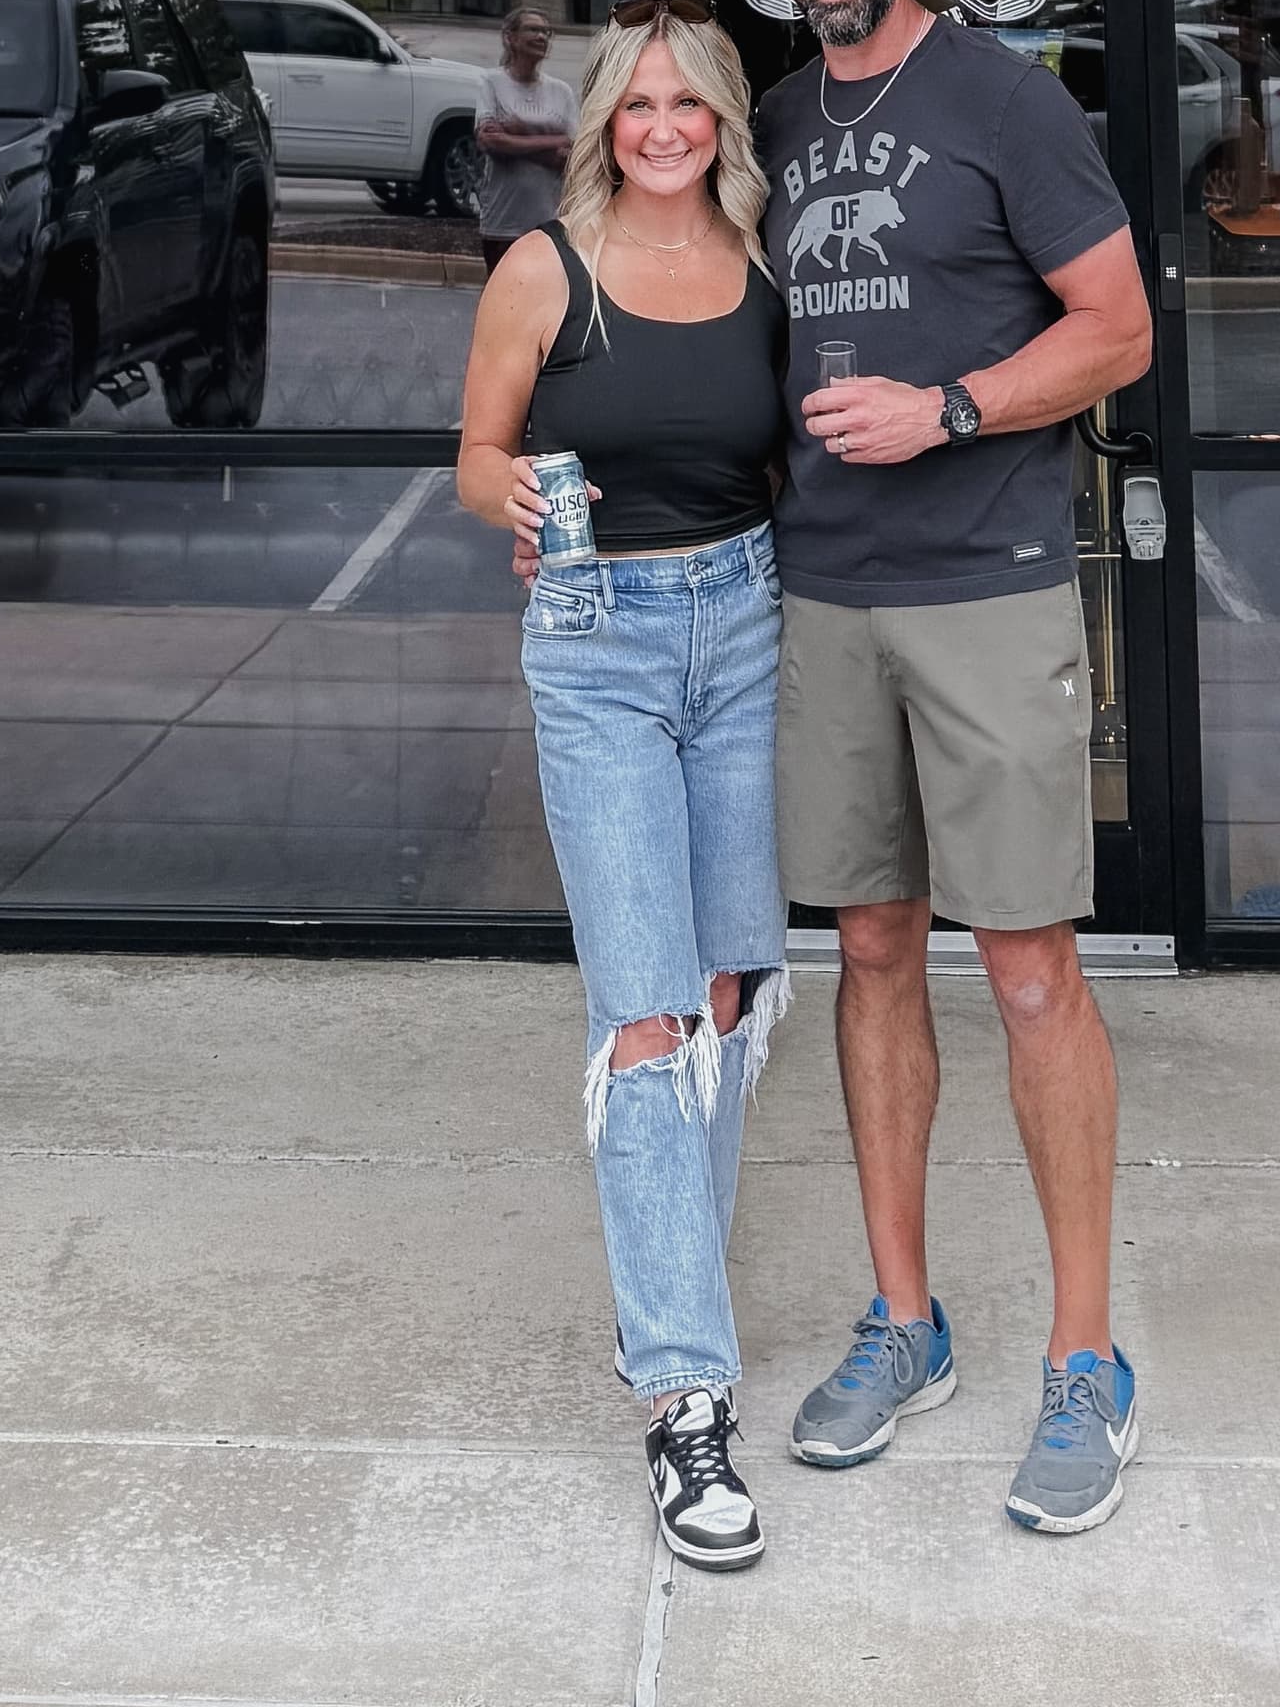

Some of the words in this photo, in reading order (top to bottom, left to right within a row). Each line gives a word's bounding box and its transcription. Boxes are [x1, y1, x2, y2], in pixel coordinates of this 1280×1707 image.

[783, 130, 931, 204] BEAST
[831, 199, 860, 231] OF
[788, 275, 910, 319] BOURBON
